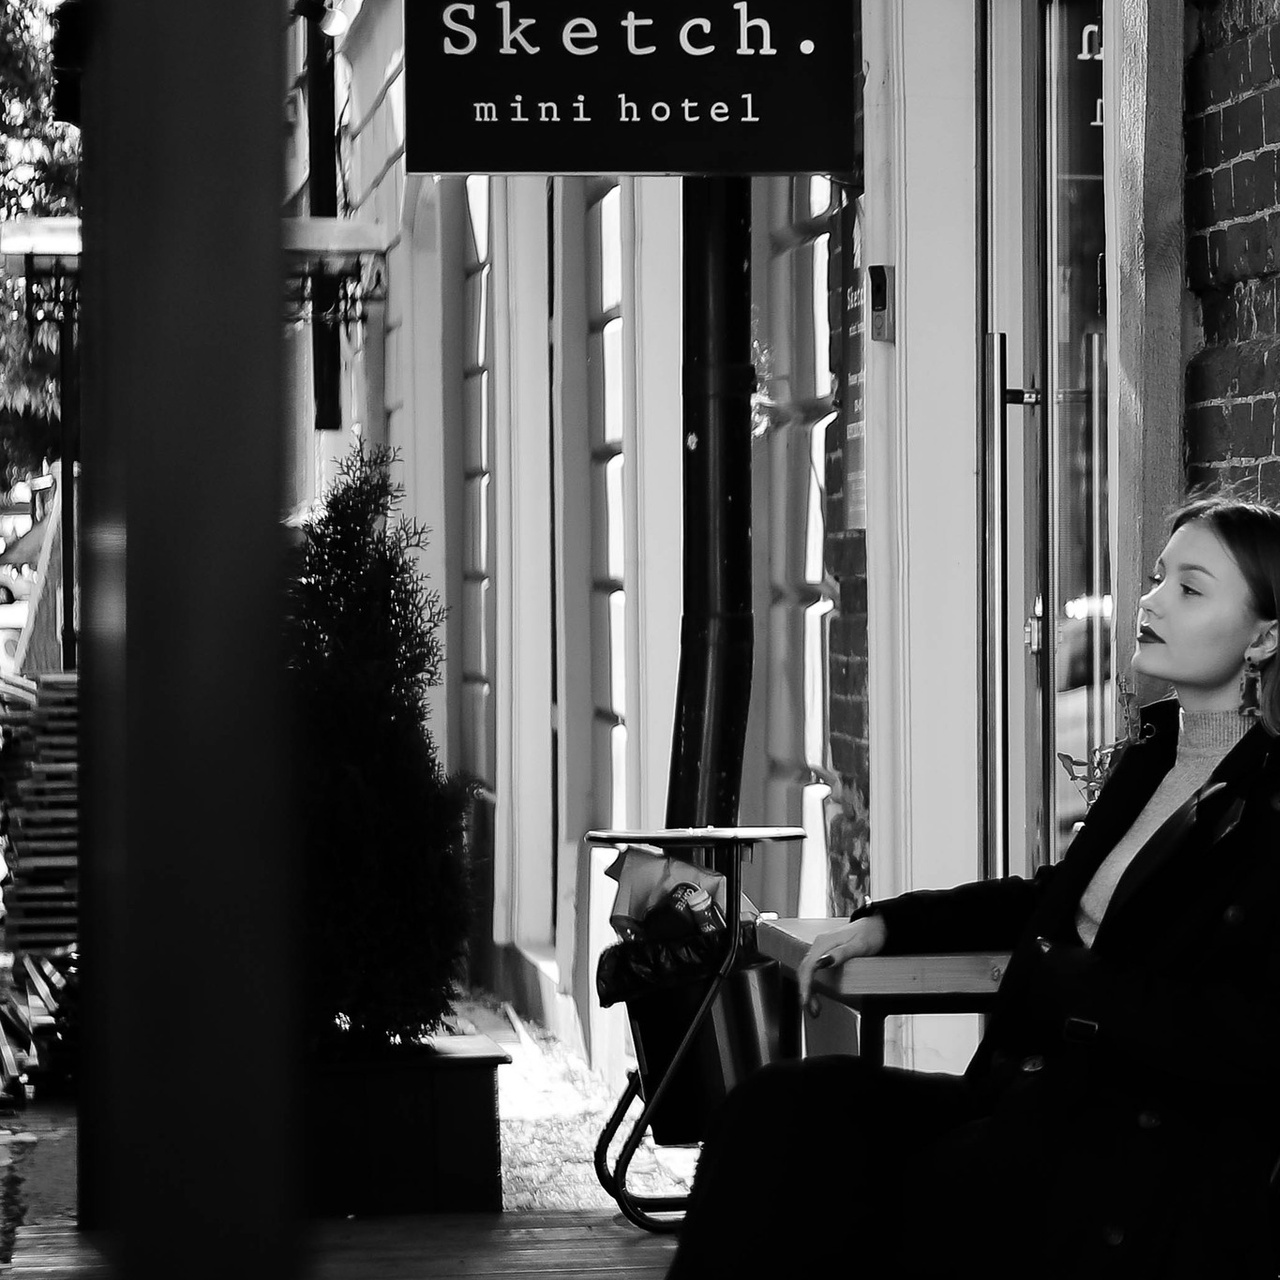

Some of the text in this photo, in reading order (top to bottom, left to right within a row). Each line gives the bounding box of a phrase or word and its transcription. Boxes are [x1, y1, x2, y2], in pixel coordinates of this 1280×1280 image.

[442, 0, 815, 56] Sketch.
[473, 93, 760, 122] mini hotel
